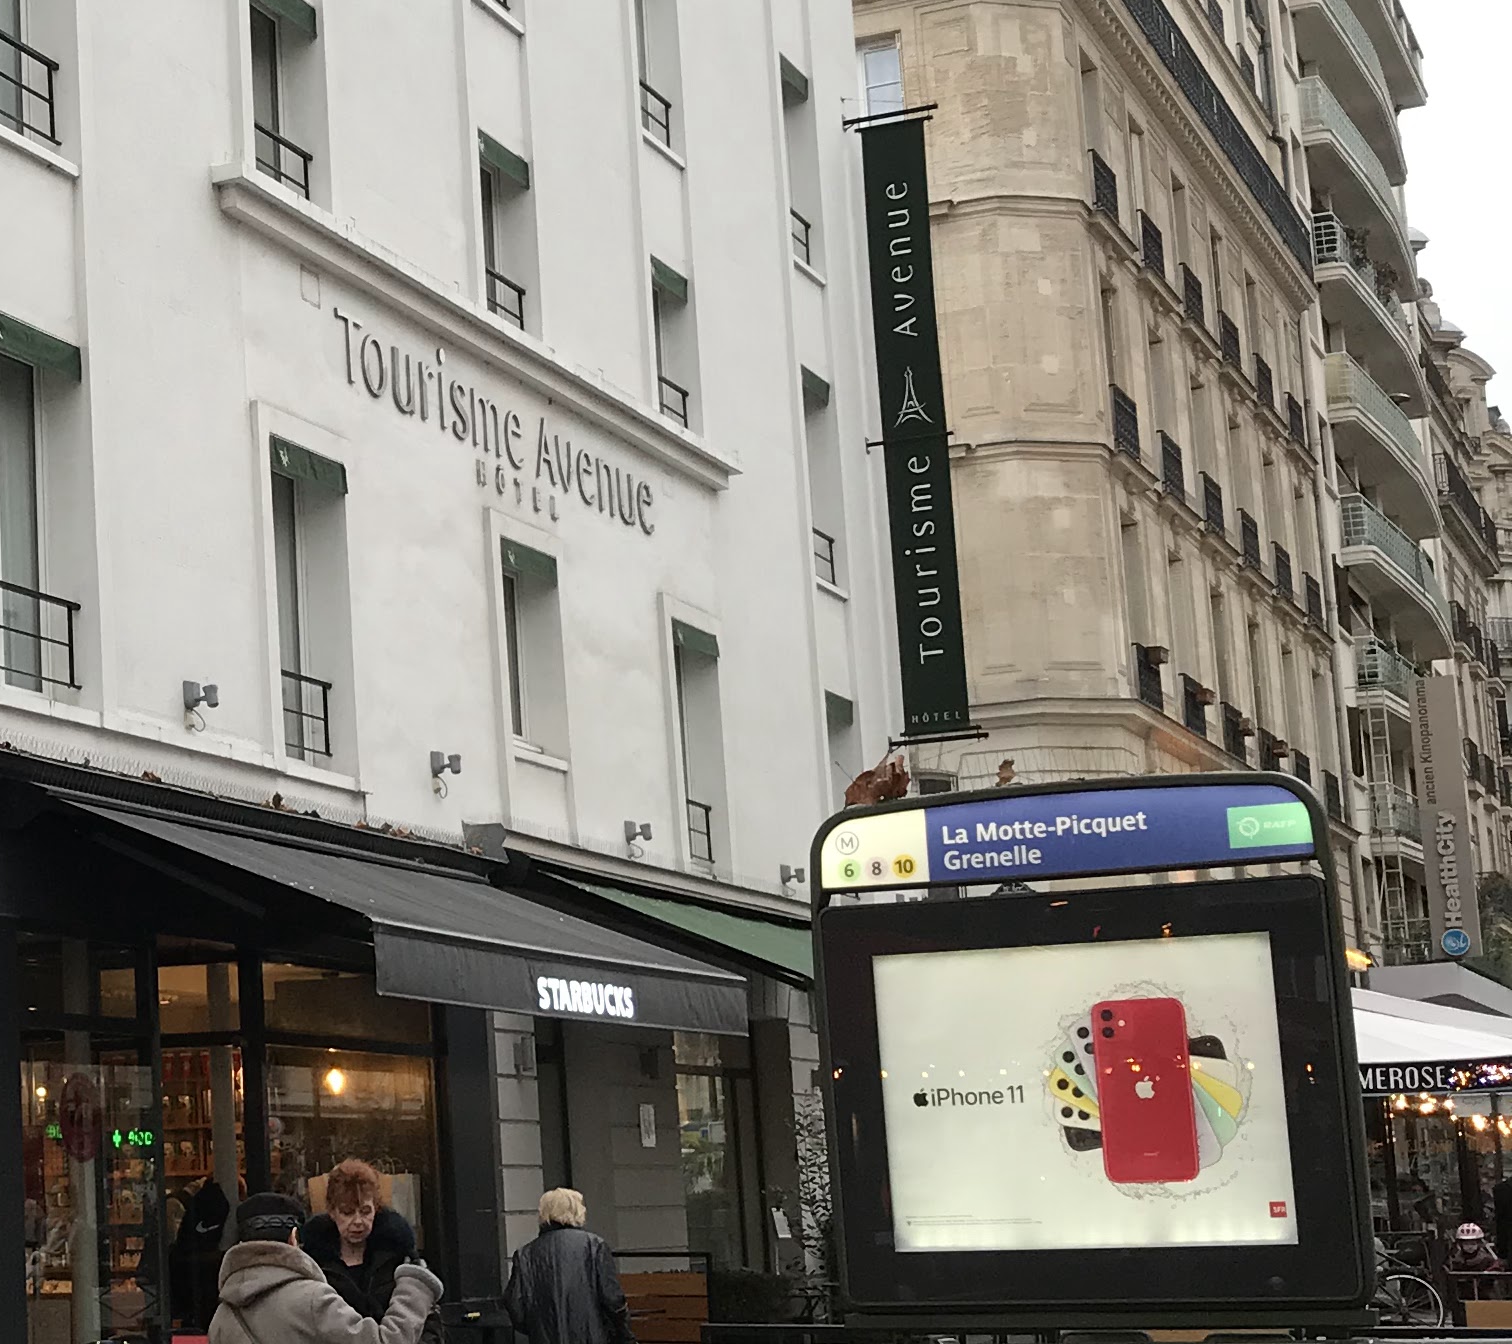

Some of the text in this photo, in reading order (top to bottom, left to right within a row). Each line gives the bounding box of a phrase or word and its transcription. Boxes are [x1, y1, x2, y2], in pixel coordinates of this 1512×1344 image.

[334, 307, 655, 535] Tourisme Avenue
[885, 182, 944, 664] Tourisme Avenue
[911, 709, 962, 725] HÔTEL
[1416, 679, 1436, 805] ancien Kinopanorama
[941, 811, 1148, 845] La Motte-Picquet
[844, 857, 915, 878] 6 8 10
[944, 845, 1043, 870] Grenelle
[1436, 811, 1462, 928] HealthCity
[537, 976, 635, 1019] STARBUCKS
[930, 1085, 1025, 1109] iPhone 11
